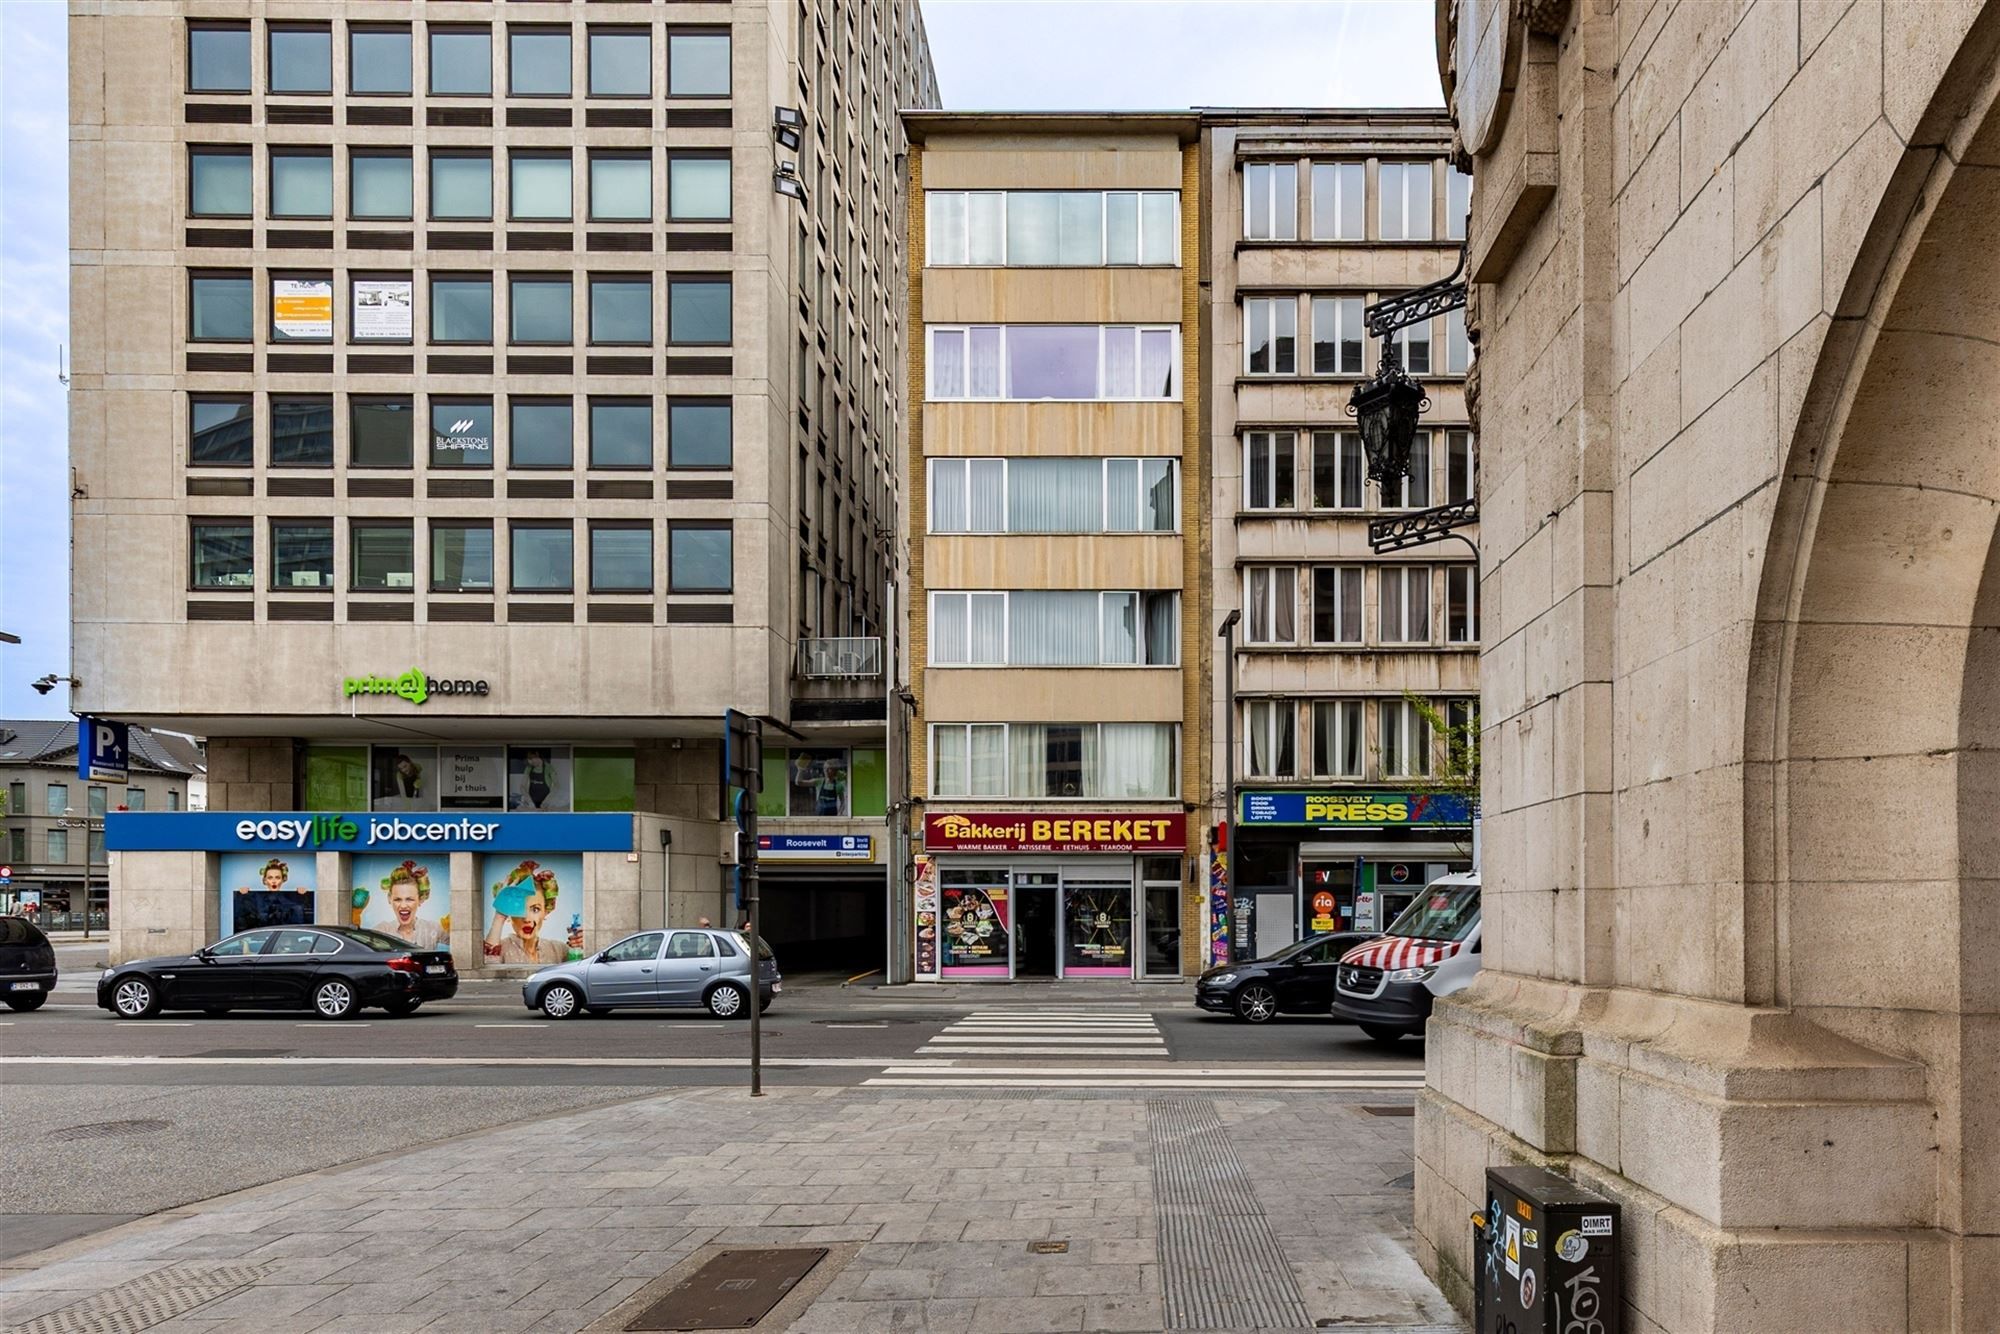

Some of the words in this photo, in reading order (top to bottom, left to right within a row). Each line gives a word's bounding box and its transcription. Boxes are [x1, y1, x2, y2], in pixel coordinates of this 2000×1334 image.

[436, 436, 489, 444] BLACKSTONE
[96, 725, 115, 757] P
[455, 754, 480, 762] Prima
[455, 764, 474, 773] hulp
[455, 775, 466, 783] bij
[455, 784, 463, 793] je
[465, 784, 487, 792] thuis
[1306, 795, 1373, 804] ROOSEVELT
[1306, 804, 1408, 821] PRESS
[367, 817, 499, 844] jobcenter
[945, 822, 1026, 842] Bakkerij
[1032, 820, 1172, 841] BEREKET
[786, 839, 827, 847] Roosevelt
[1315, 895, 1332, 907] ria
[1583, 1218, 1611, 1228] OIMRT
